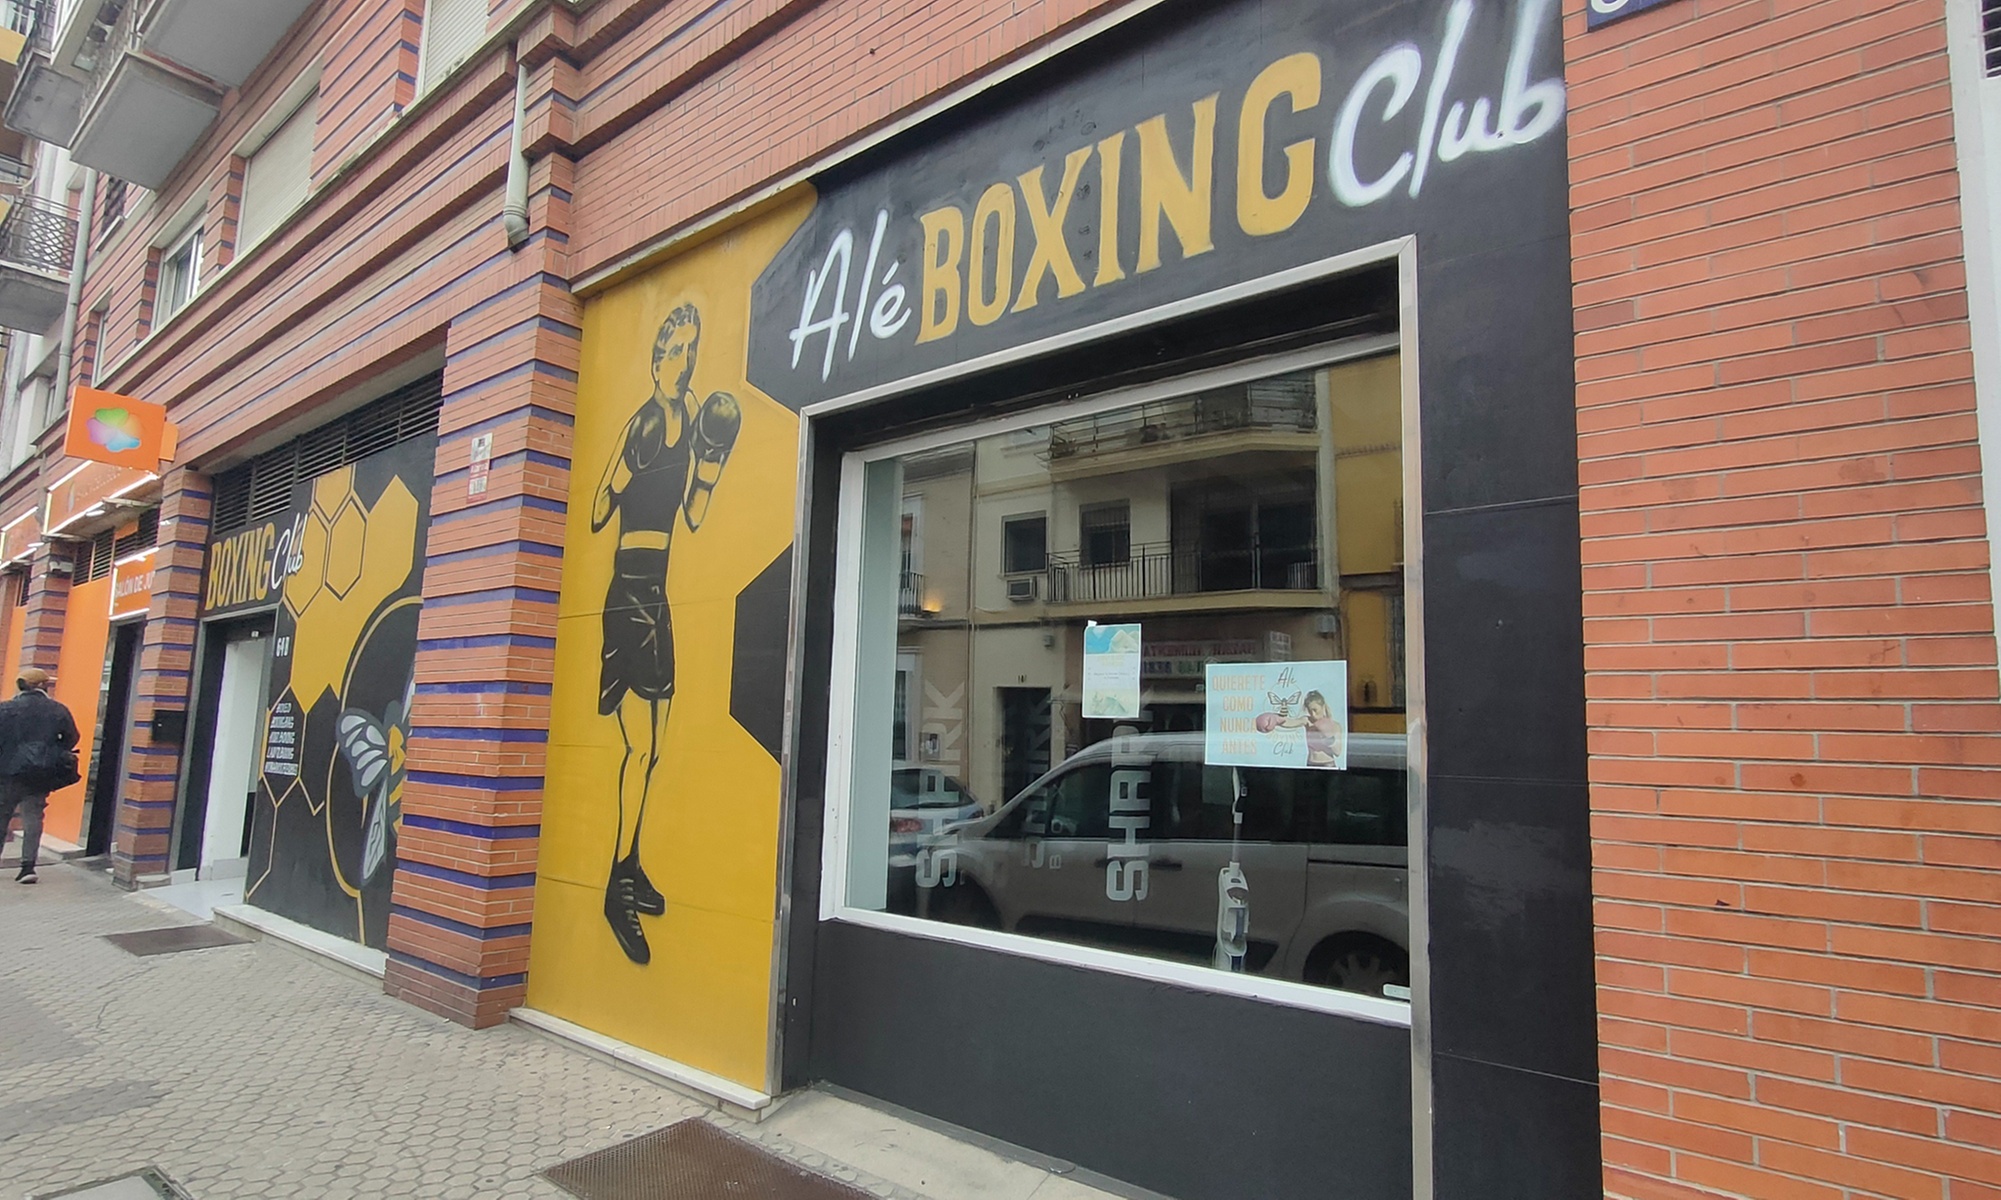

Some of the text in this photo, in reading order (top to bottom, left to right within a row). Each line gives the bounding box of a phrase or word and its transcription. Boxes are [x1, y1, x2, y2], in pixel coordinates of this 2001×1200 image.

[788, 0, 1566, 384] Alé BOXING Club
[204, 512, 307, 611] BOXING Club
[134, 574, 144, 593] DE
[1212, 675, 1265, 691] QUIERETE
[1222, 696, 1254, 712] COMO
[1220, 717, 1257, 733] NUNCA
[1222, 738, 1257, 755] ANTES
[1273, 741, 1294, 757] Club
